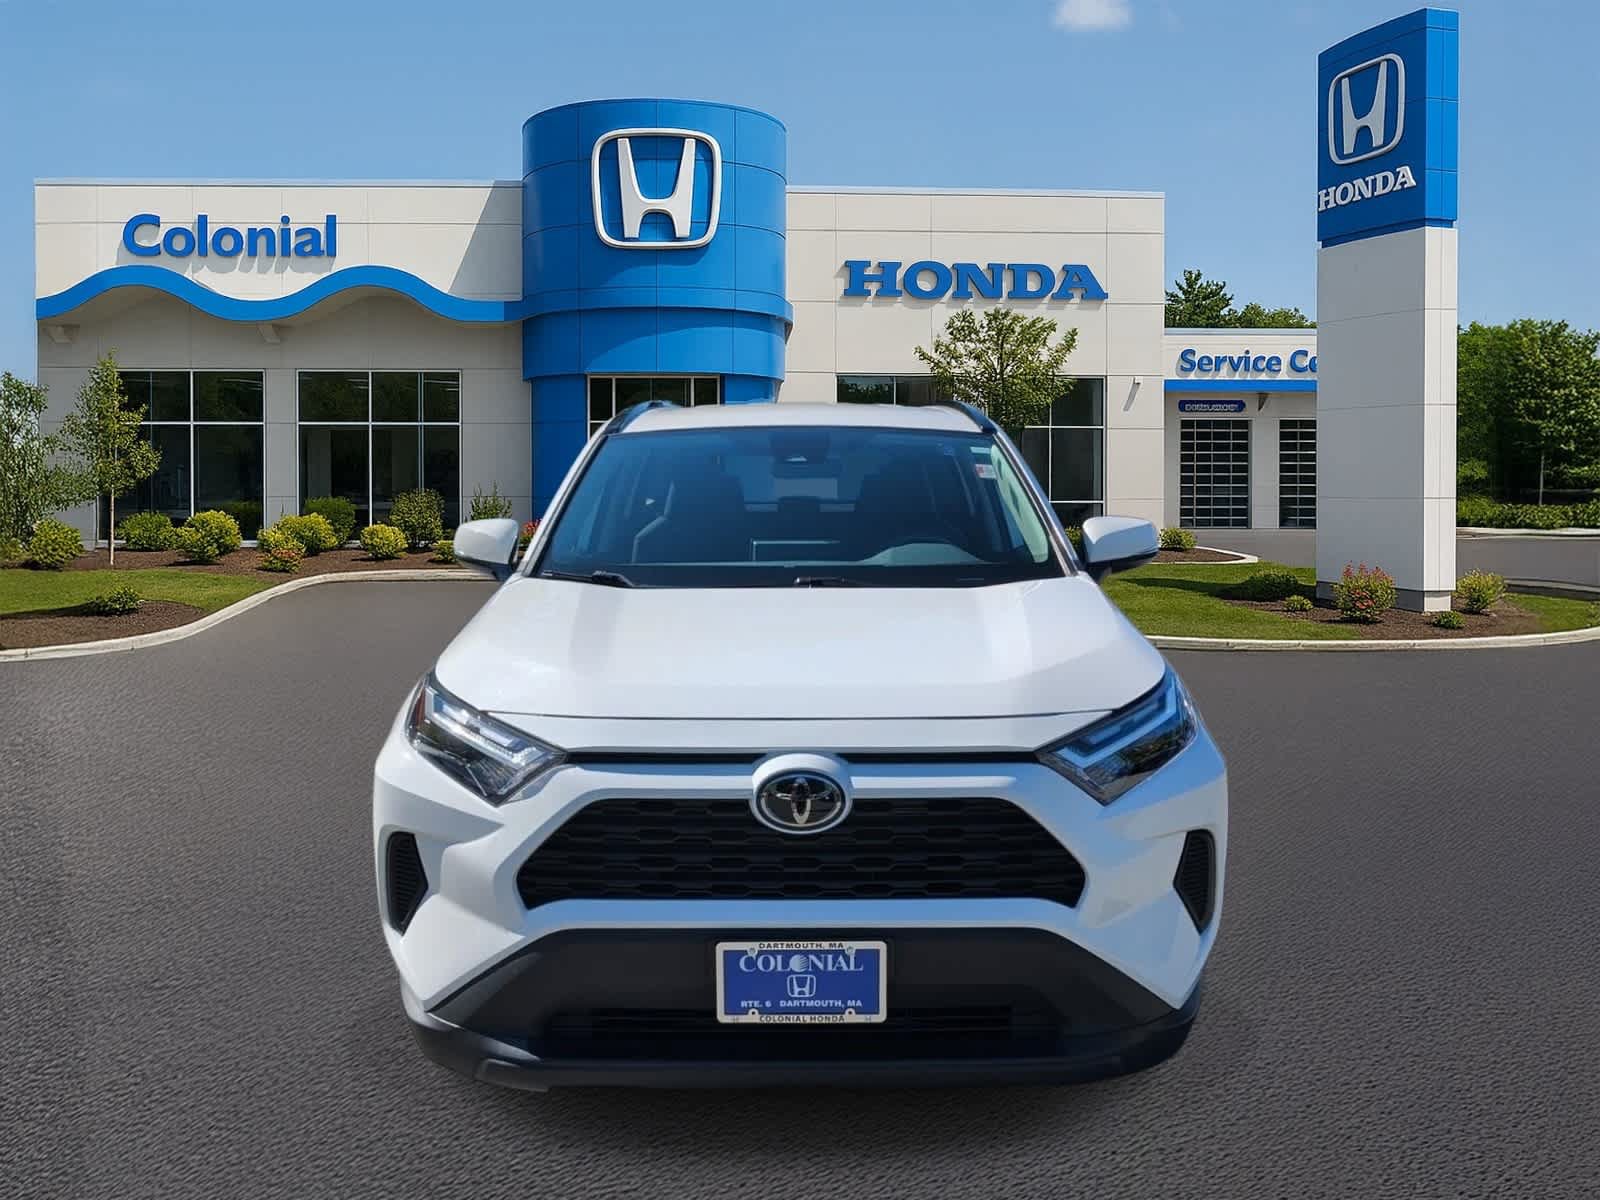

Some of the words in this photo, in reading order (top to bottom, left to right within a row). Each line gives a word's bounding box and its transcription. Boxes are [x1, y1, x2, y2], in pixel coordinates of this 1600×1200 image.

[1318, 165, 1417, 212] HONDA
[122, 213, 337, 257] Colonial
[843, 260, 1109, 300] HONDA
[1180, 349, 1282, 373] Service
[759, 942, 824, 950] DARTMOUTH,
[739, 954, 864, 973] COLONIAL
[765, 1000, 772, 1008] 6
[779, 1000, 845, 1009] DARTMOUTH,
[847, 1000, 863, 1008] MA
[759, 1015, 807, 1023] COLONIAL
[810, 1015, 845, 1023] HONDA
